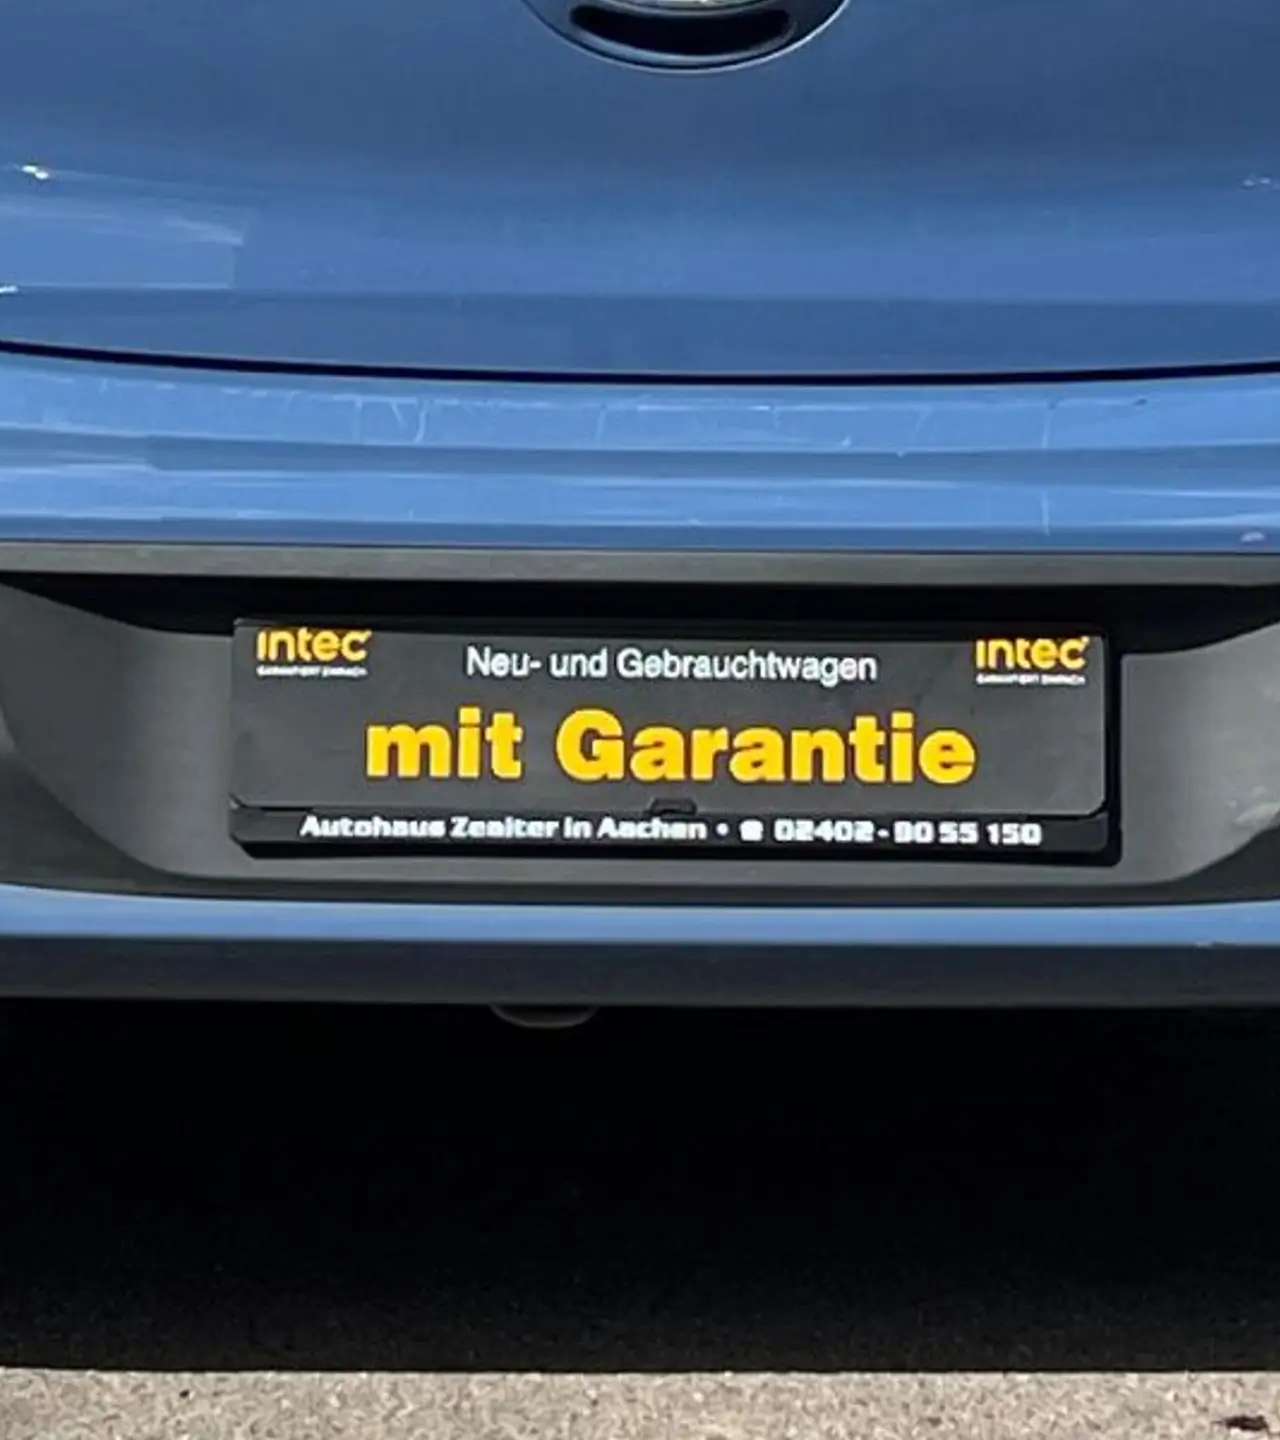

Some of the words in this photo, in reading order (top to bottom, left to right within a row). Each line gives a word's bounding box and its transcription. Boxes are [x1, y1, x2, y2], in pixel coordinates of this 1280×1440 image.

[256, 627, 372, 661] intec
[975, 636, 1090, 670] intec
[466, 646, 541, 677] Neu-
[549, 647, 608, 678] und
[616, 647, 878, 688] Gebrauchtwagen
[365, 707, 523, 779] mit
[555, 708, 976, 784] Garantie
[299, 815, 446, 838] Autohaus
[596, 816, 708, 840] Aachen
[774, 818, 875, 842] 02402
[938, 820, 979, 844] 55
[986, 822, 1043, 846] 150
